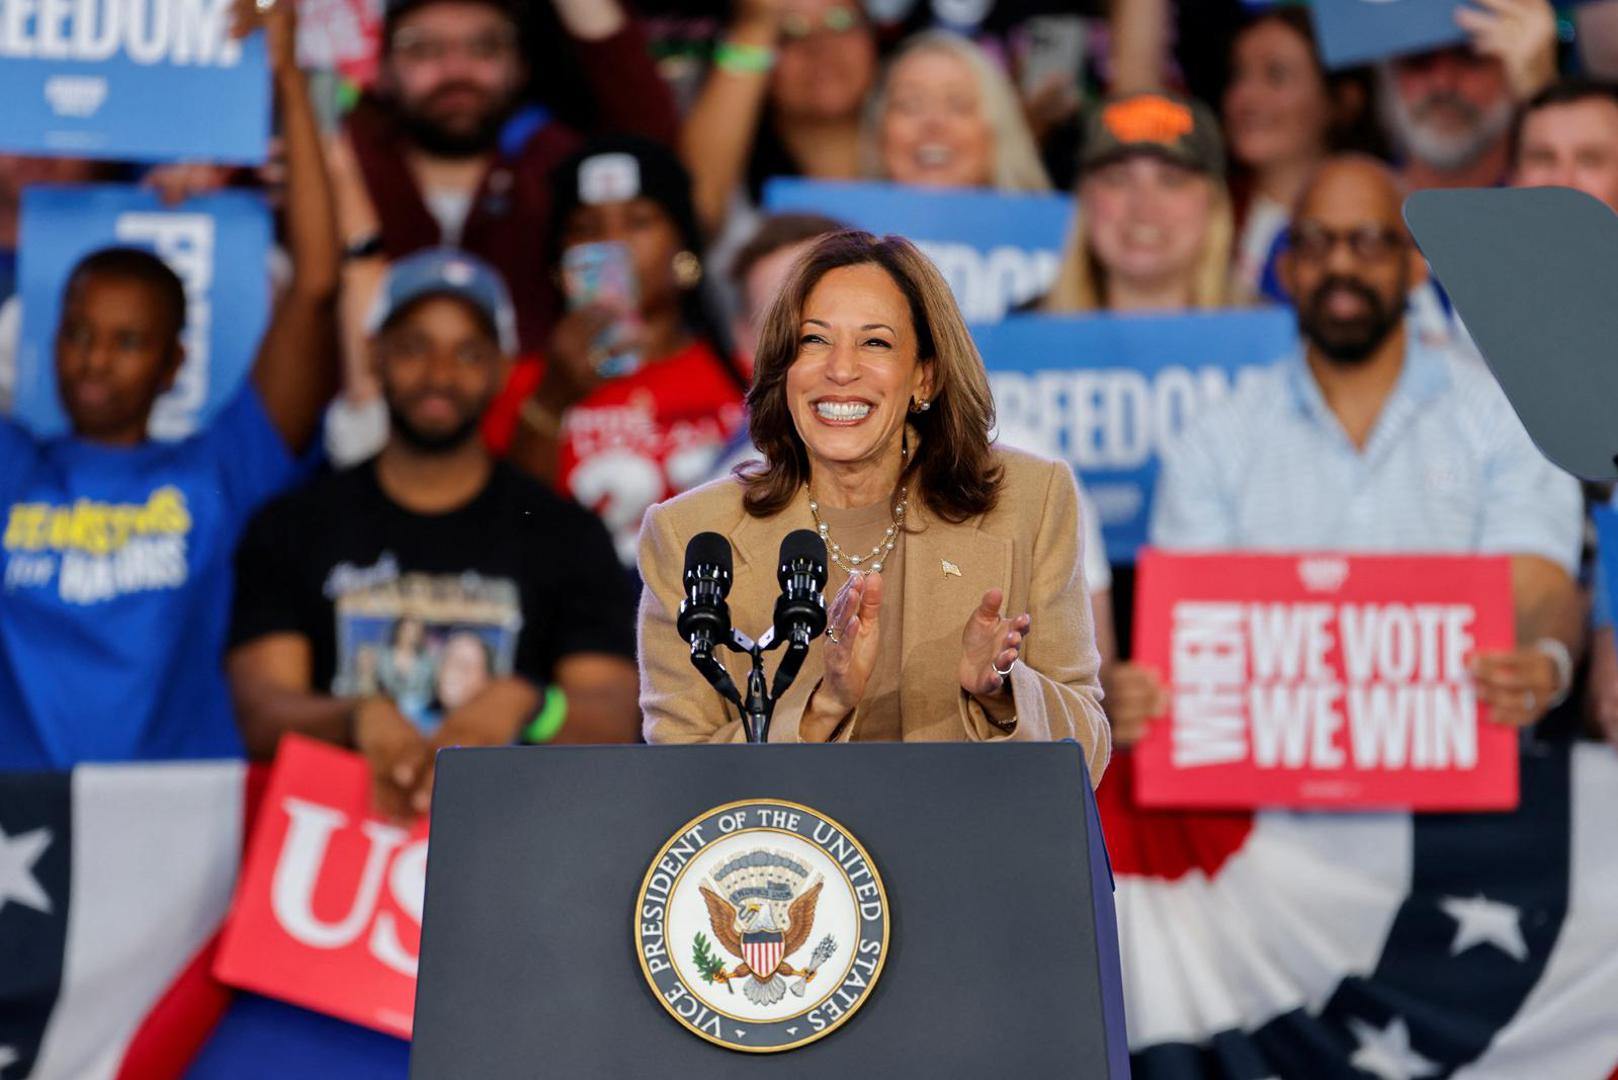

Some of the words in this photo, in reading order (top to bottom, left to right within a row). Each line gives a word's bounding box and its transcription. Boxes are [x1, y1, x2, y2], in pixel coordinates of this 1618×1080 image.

[1171, 602, 1247, 767] WHEN
[1249, 602, 1335, 681] WE
[1339, 603, 1475, 682] VOTE
[1250, 682, 1346, 769] WE
[1346, 682, 1478, 770] WIN
[718, 811, 747, 833] OF
[757, 809, 801, 832] THE
[642, 825, 709, 974] PRESIDENT
[812, 821, 882, 922] UNITED
[664, 981, 723, 1038] VICE
[808, 939, 881, 1030] STATES
